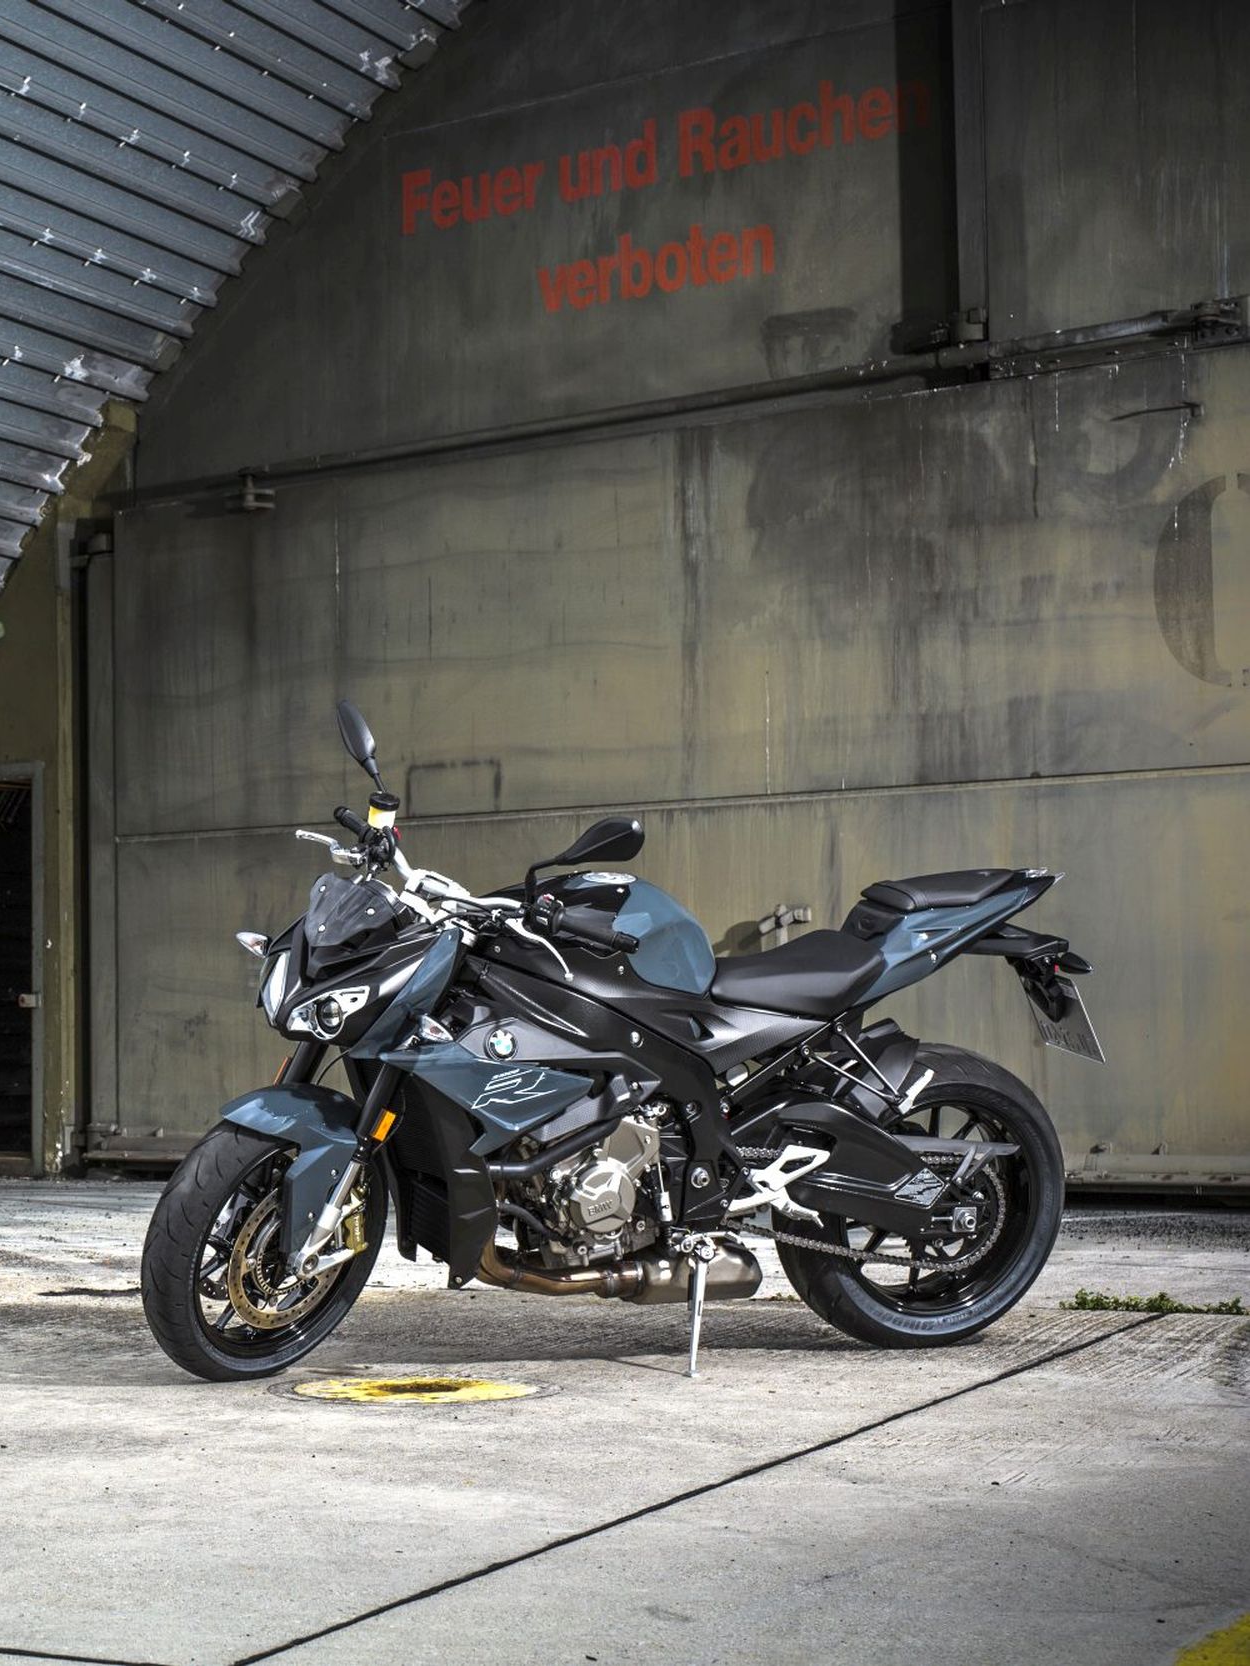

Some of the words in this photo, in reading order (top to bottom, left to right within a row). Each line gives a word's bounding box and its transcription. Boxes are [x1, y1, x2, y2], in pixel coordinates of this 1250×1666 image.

[400, 160, 545, 235] Feuer
[557, 118, 659, 204] und
[675, 79, 932, 178] Rauchen
[536, 221, 776, 312] verboten
